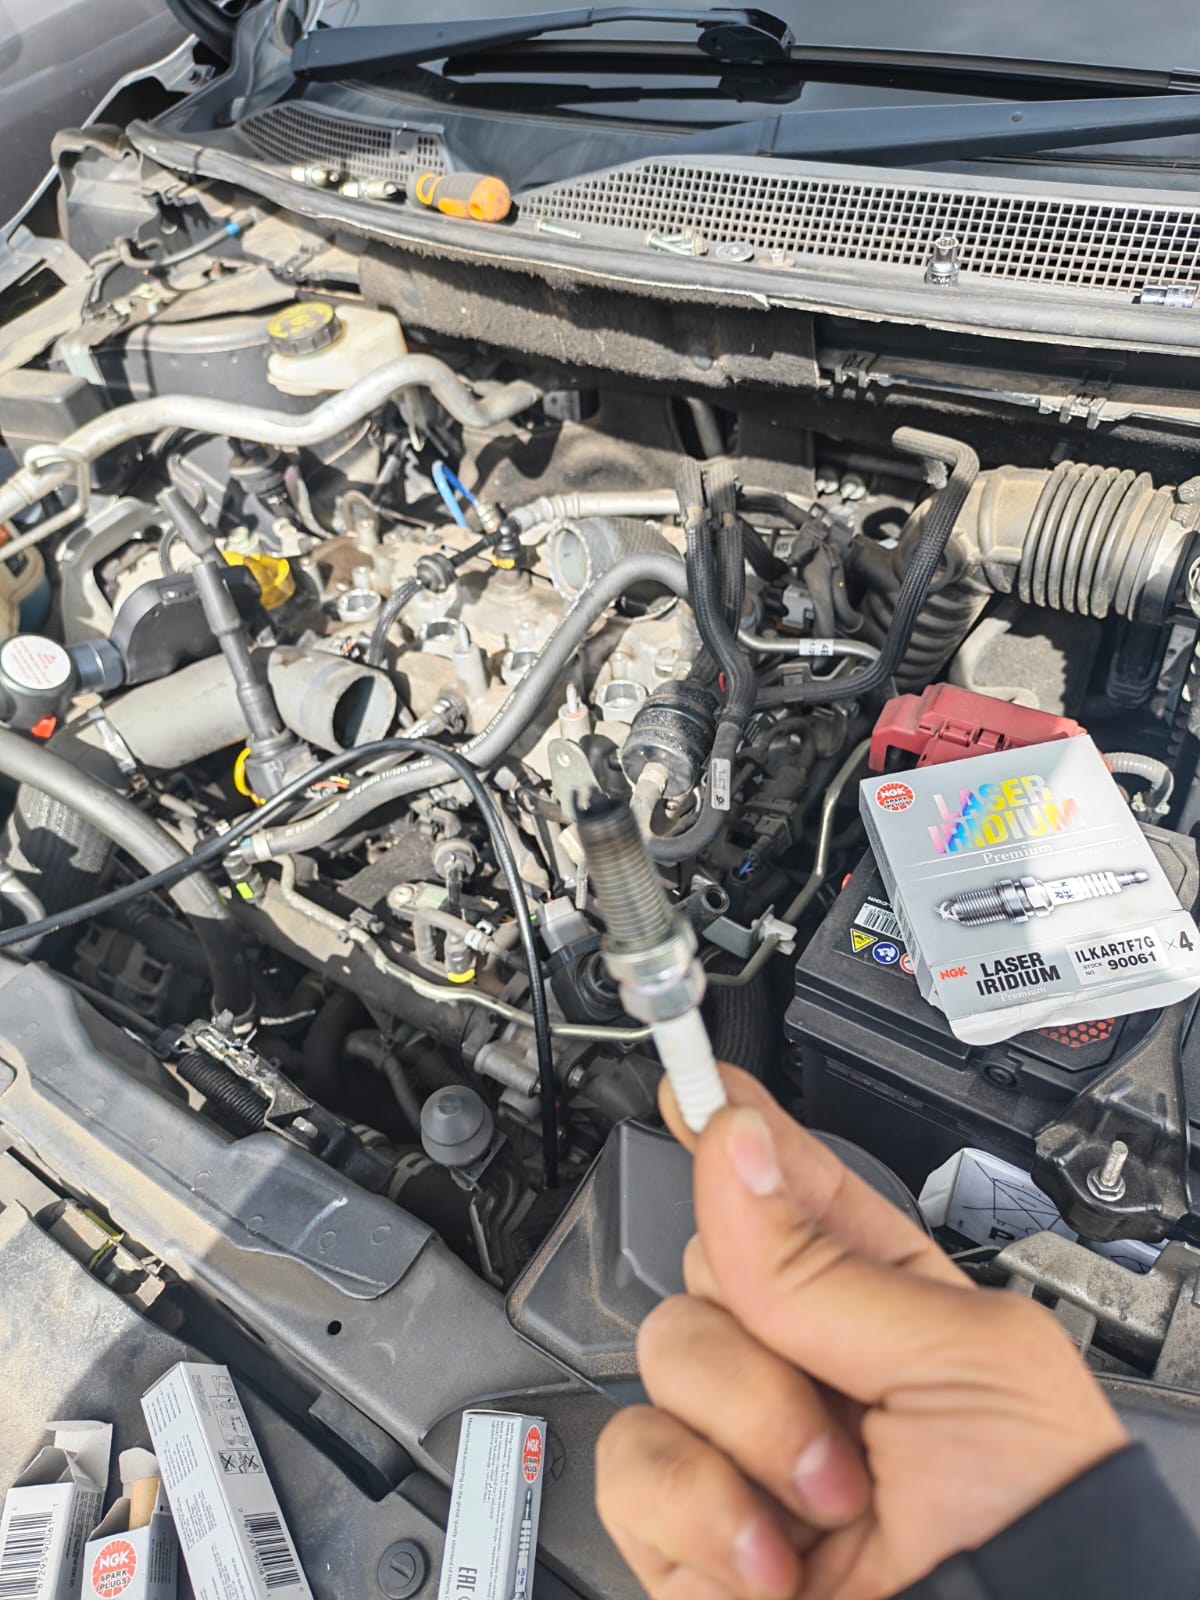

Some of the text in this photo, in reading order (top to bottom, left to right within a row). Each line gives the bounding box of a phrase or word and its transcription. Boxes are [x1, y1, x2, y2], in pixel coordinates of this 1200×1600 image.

[880, 786, 906, 799] NGK
[933, 774, 1052, 820] LASER
[928, 796, 1084, 854] IRIDIUM
[982, 843, 1054, 865] Premium
[1075, 935, 1155, 964] ILKAR7F7G
[980, 951, 1045, 978] LASER
[1083, 961, 1104, 971] STOCK
[1107, 951, 1158, 971] 90061
[940, 966, 968, 981] NGK
[976, 964, 1062, 996] IRIDIUM
[999, 986, 1048, 1002] Premium
[526, 1438, 540, 1453] NGK
[99, 1549, 130, 1570] NGK
[99, 1578, 128, 1591] PLUGS
[100, 1570, 128, 1583] SPARK
